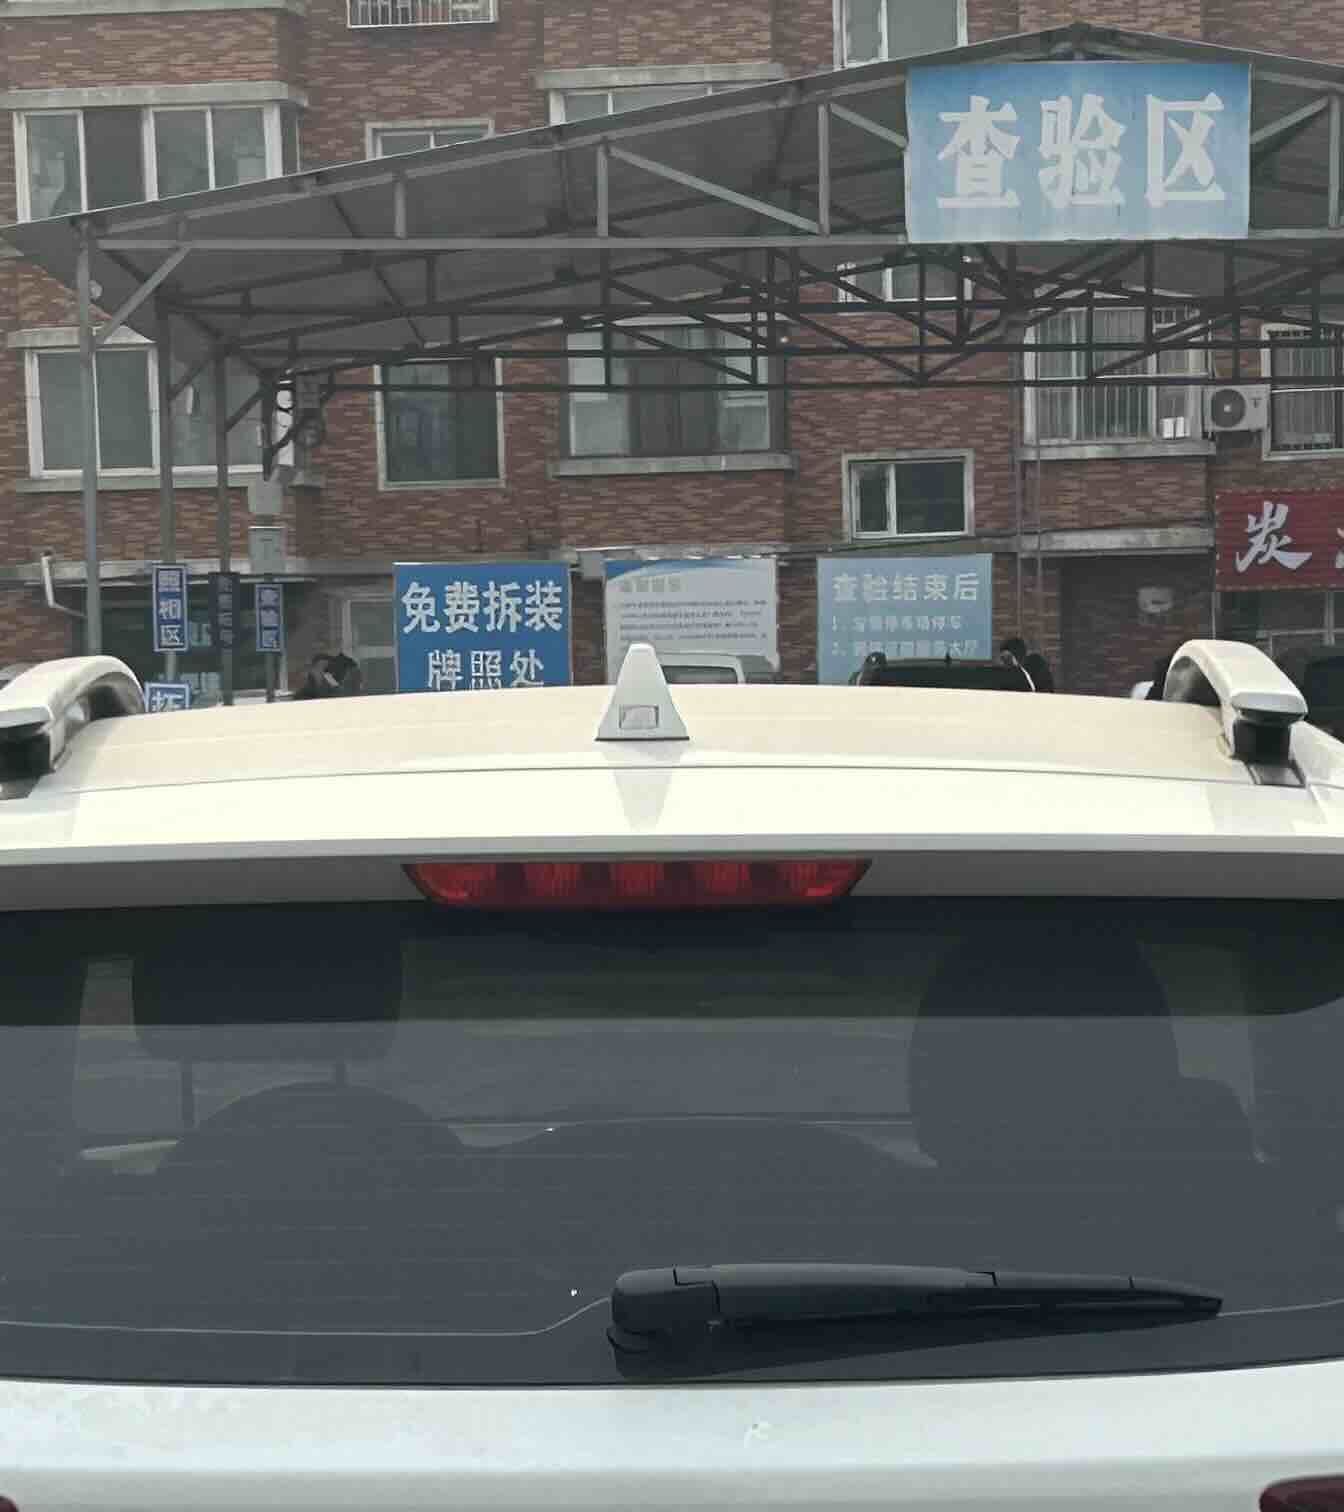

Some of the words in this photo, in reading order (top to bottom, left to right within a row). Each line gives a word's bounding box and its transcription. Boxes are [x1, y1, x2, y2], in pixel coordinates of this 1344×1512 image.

[935, 91, 1226, 209] 查验区
[401, 580, 564, 634] 免费拆装
[831, 572, 980, 604] 查验结束后
[427, 649, 545, 691] 牌照处
